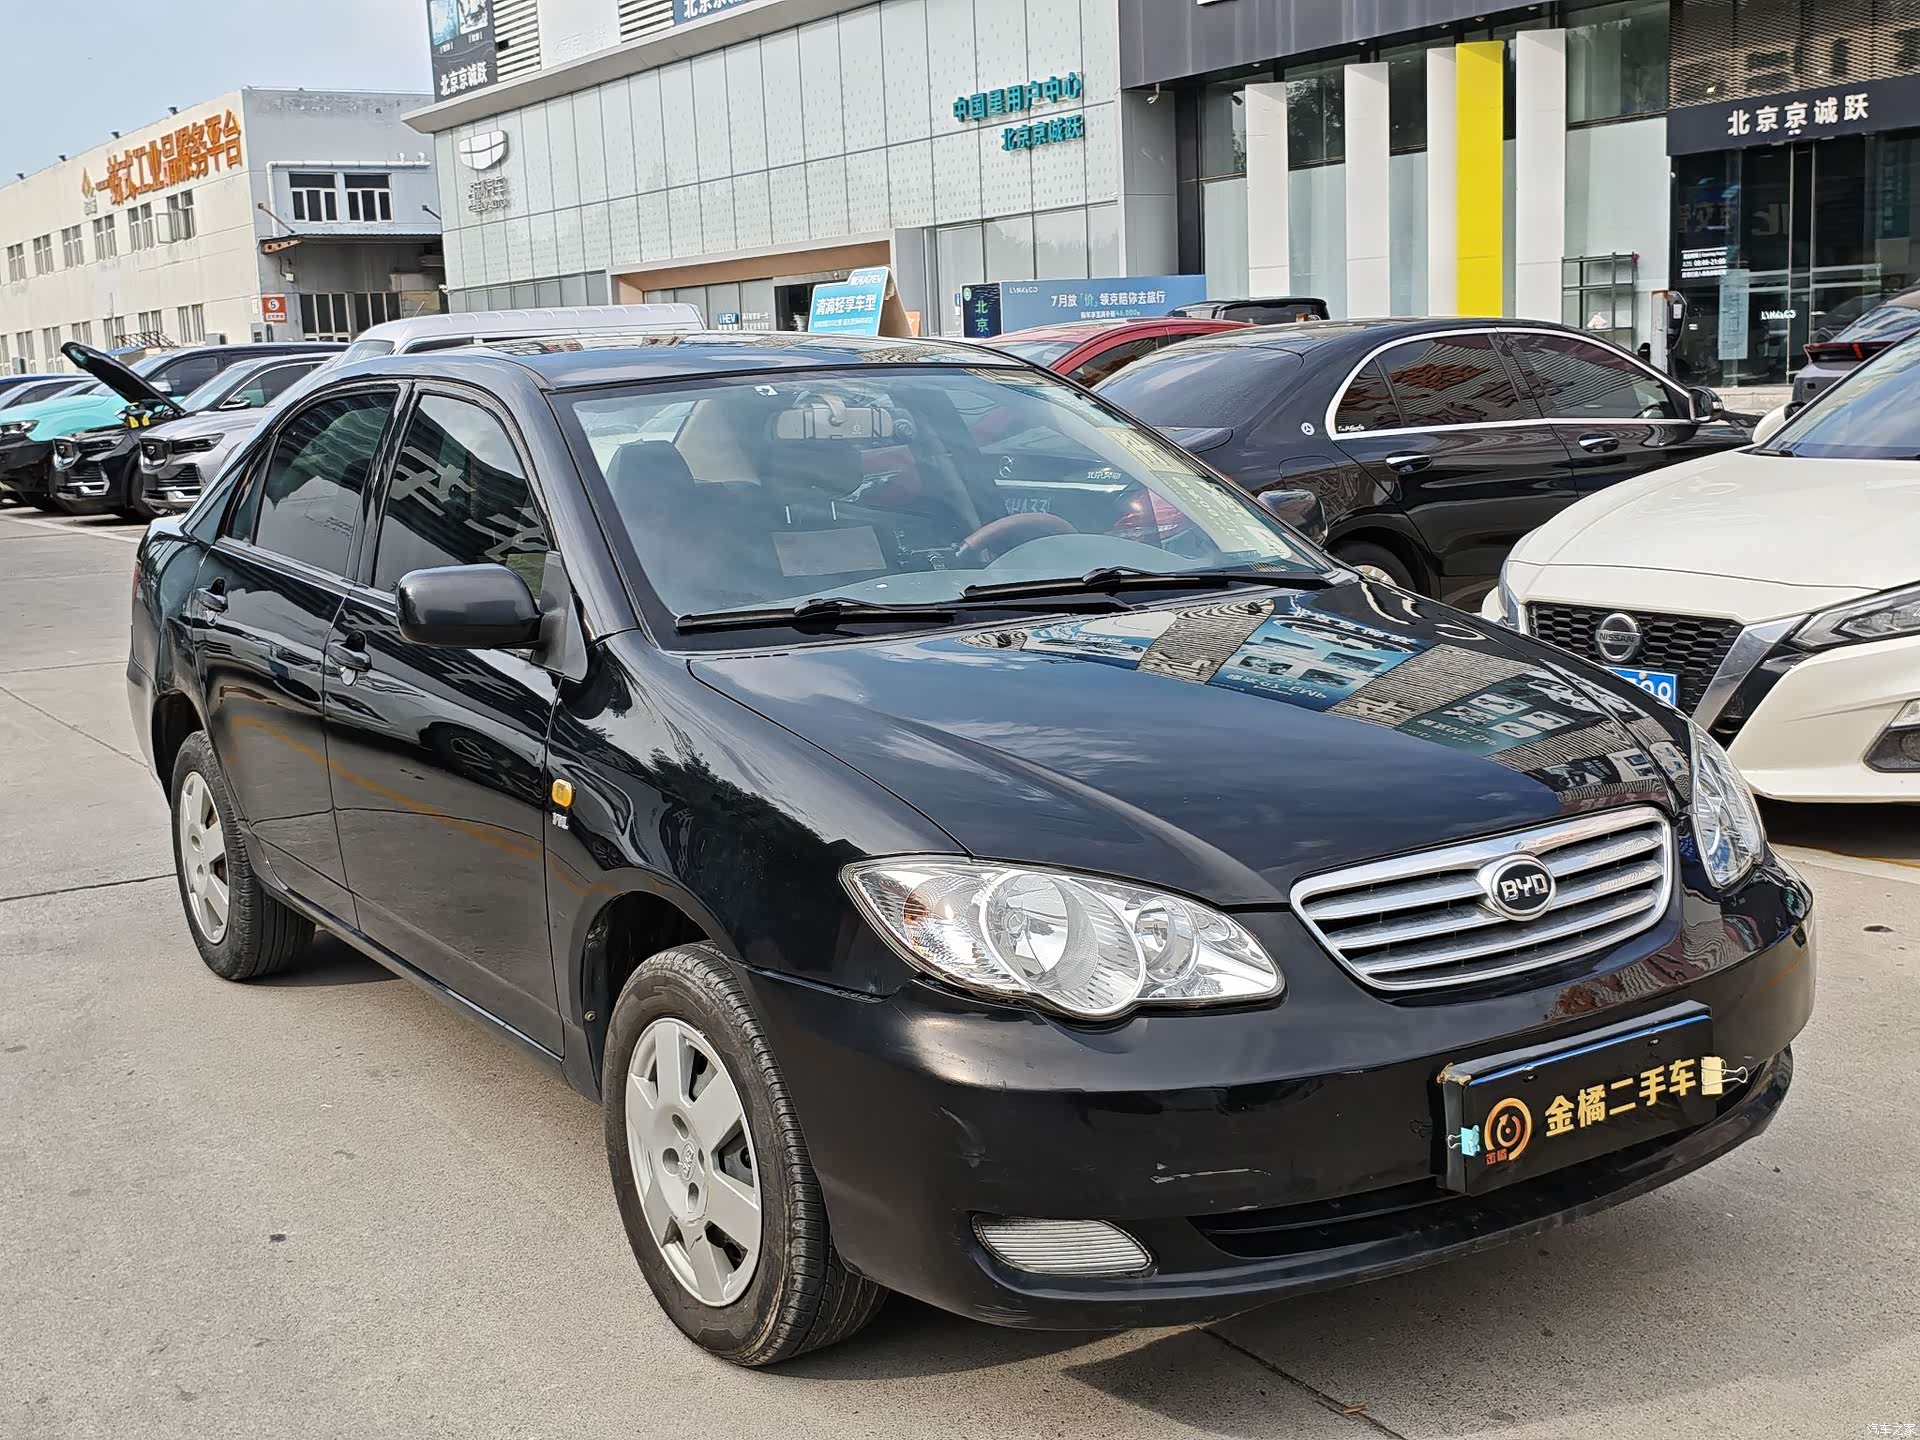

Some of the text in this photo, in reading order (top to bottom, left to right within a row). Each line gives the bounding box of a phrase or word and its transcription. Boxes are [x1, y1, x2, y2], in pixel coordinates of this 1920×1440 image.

[440, 61, 488, 97] 北京京诚跃
[952, 72, 1083, 123] 中国星用户中心
[1001, 113, 1084, 153] 北京京诚跃
[1727, 93, 1870, 137] 北京京诚跃
[1599, 632, 1635, 643] NISSAN
[1500, 873, 1549, 902] BYD
[1545, 1059, 1697, 1137] 金橘二手车
